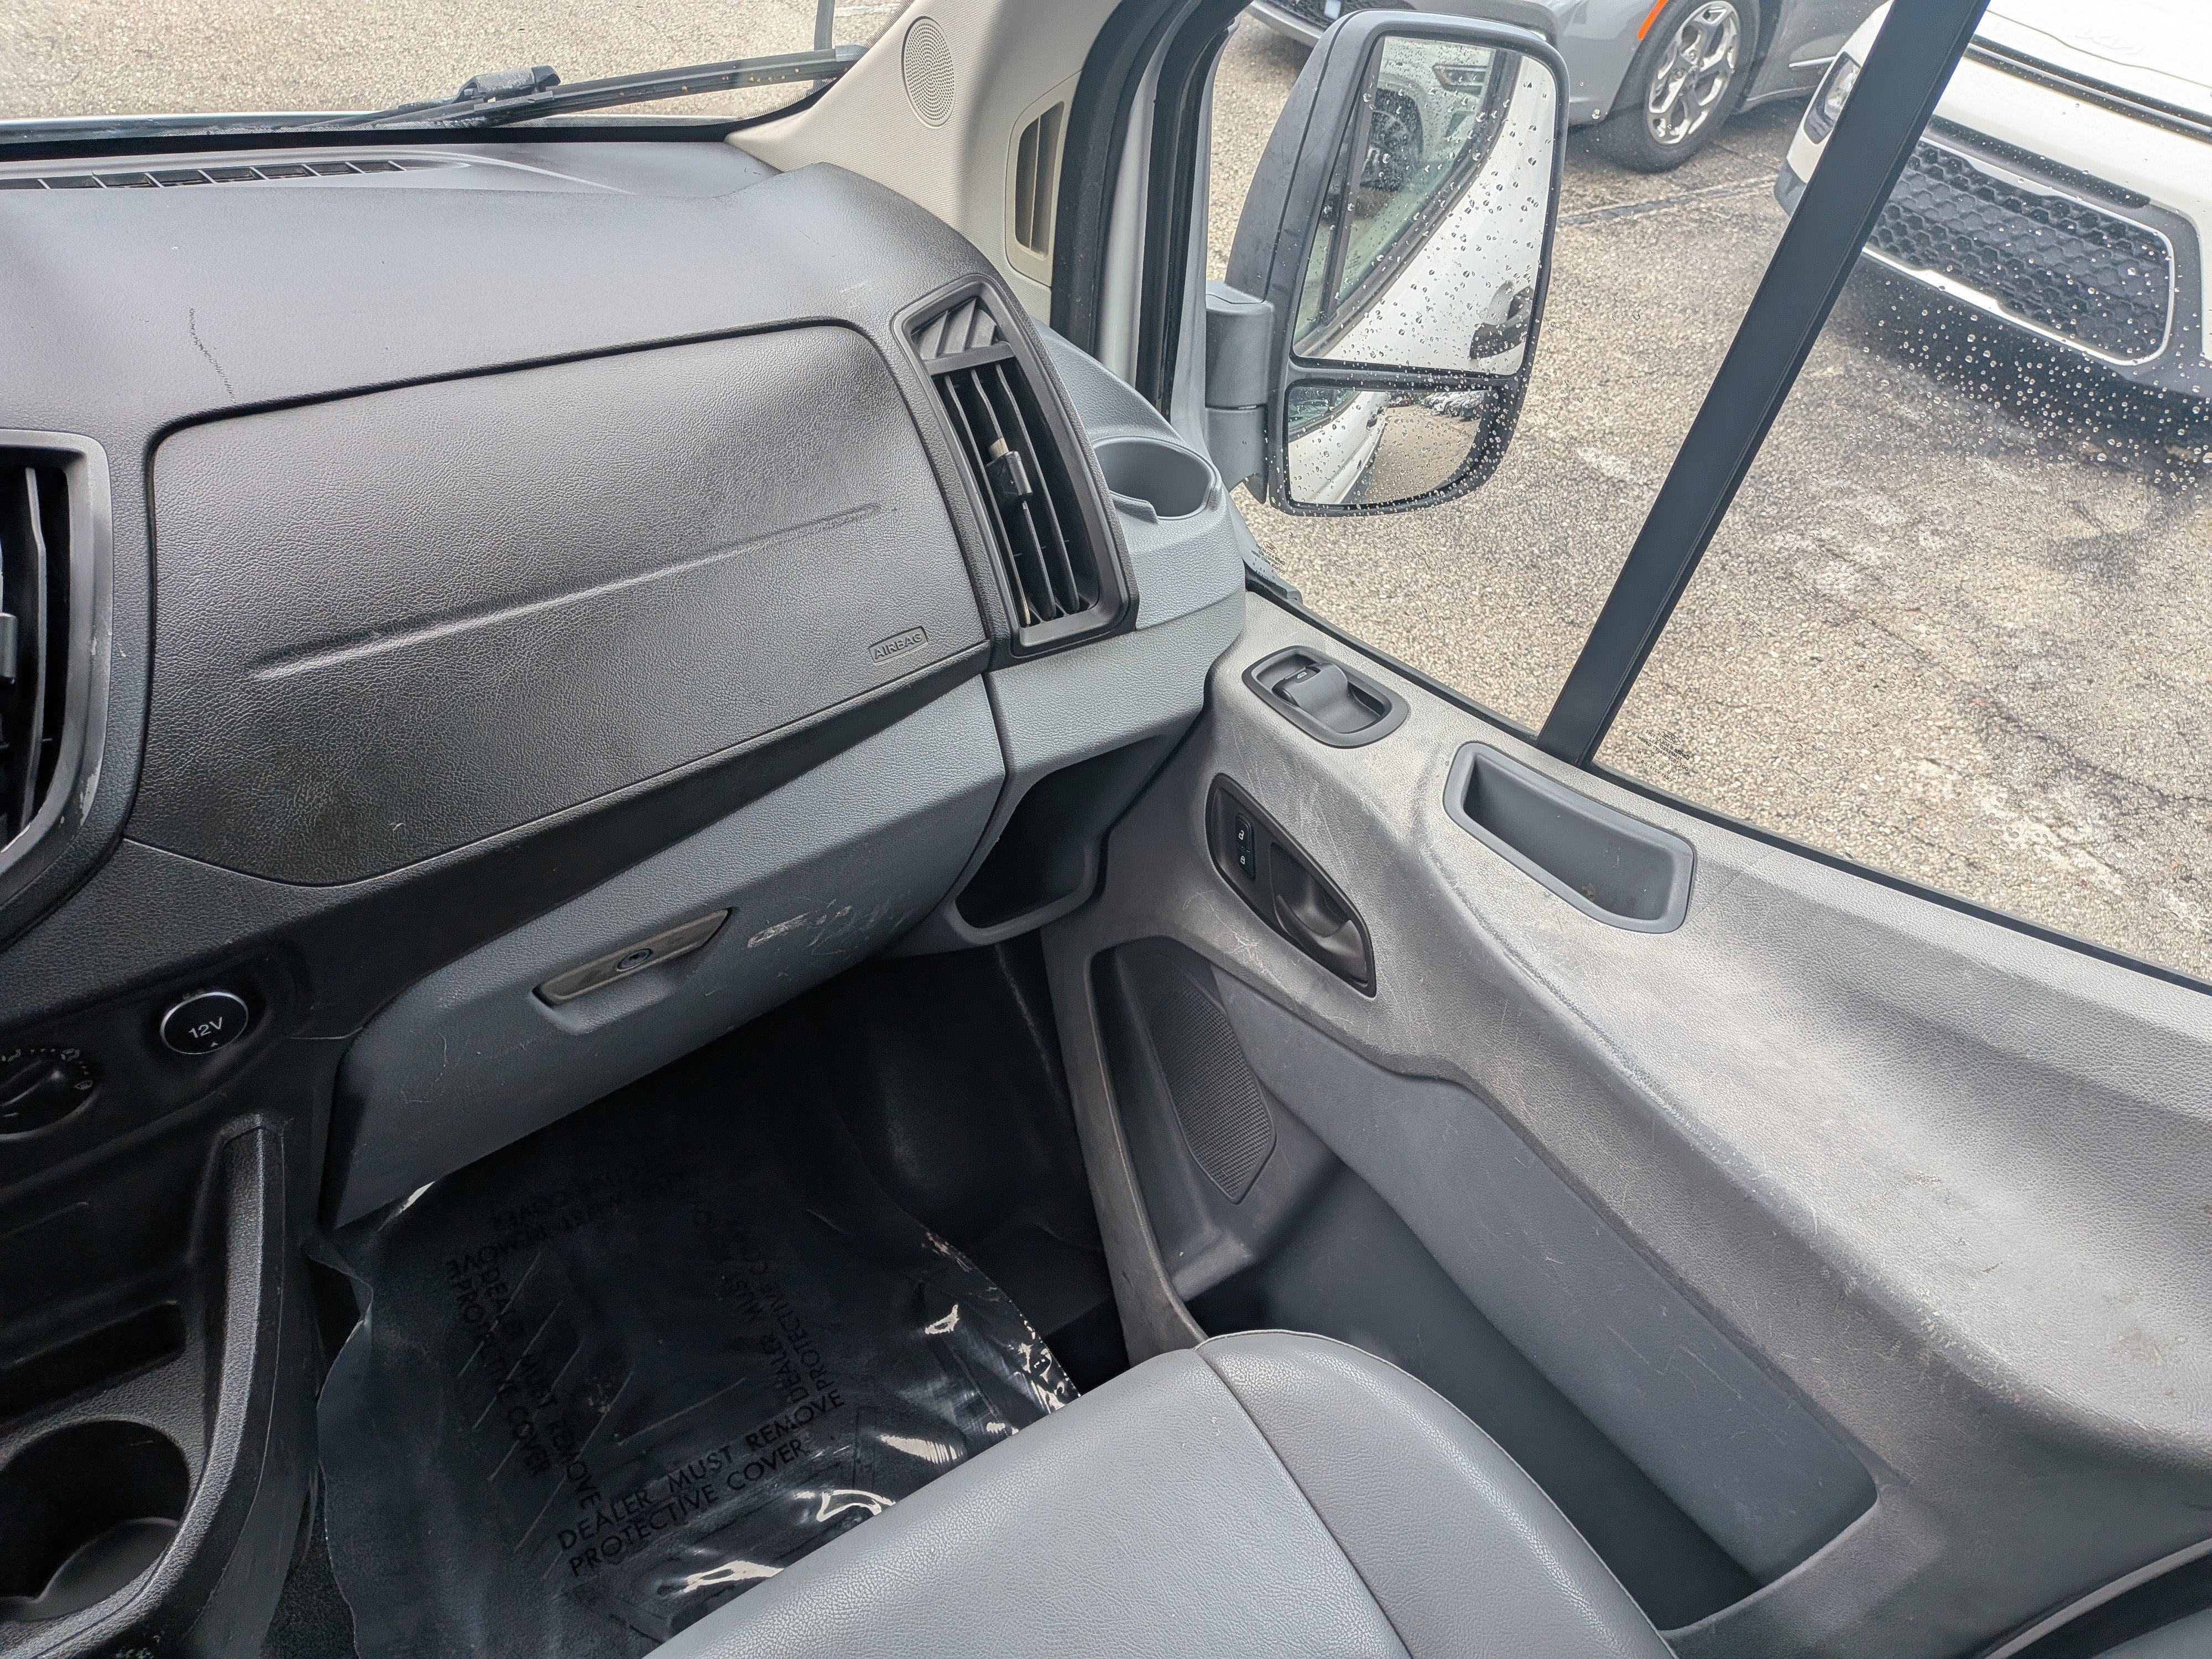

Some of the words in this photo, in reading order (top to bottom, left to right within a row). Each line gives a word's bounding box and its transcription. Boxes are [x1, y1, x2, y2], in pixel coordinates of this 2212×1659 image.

[874, 633, 922, 659] AIRBAG
[189, 1017, 222, 1038] 12V
[759, 1282, 834, 1392] PROTECTIVE
[759, 1331, 810, 1404] DEALER
[505, 1406, 552, 1478] COVER
[545, 1418, 602, 1511] REMOVE
[557, 1491, 653, 1551] DEALER
[667, 1445, 734, 1493] MUST
[746, 1389, 845, 1452] REMOVE
[569, 1484, 719, 1578] PROTECTIVE
[727, 1440, 808, 1490] COVER
